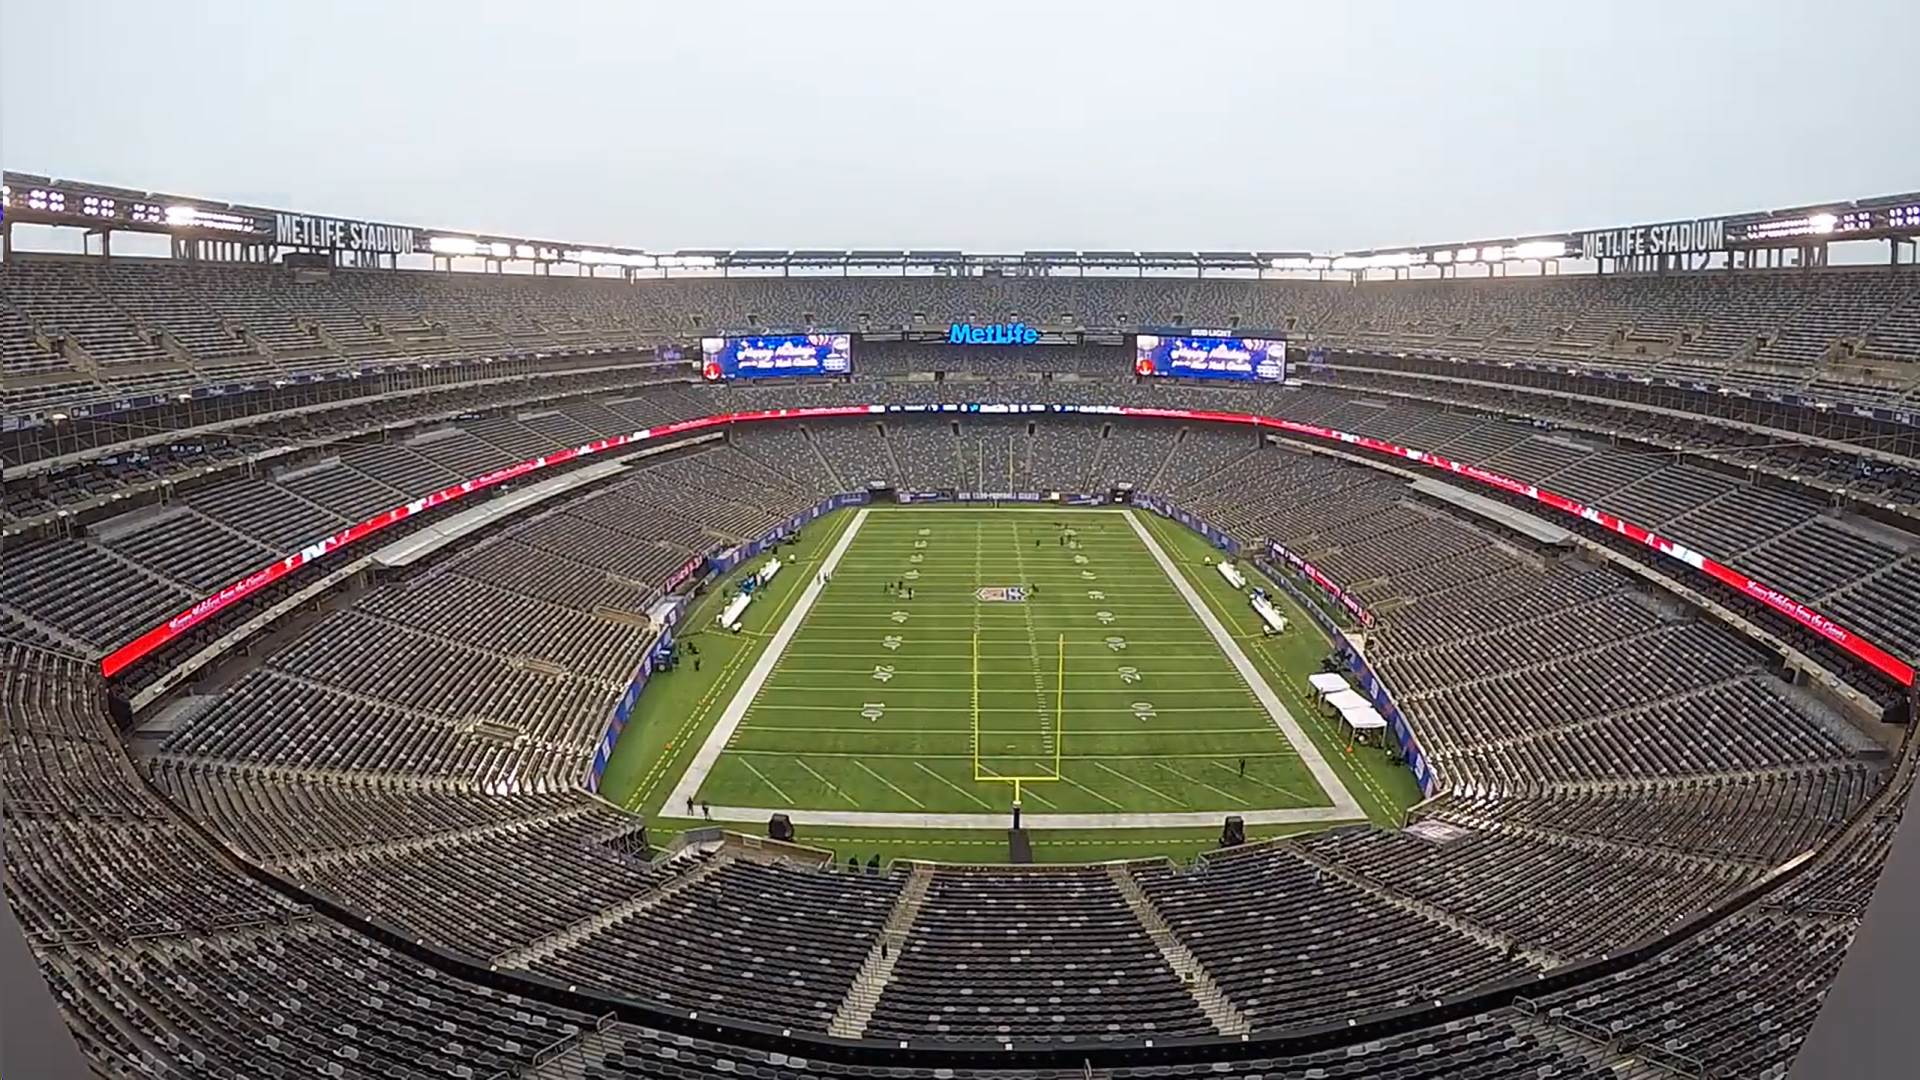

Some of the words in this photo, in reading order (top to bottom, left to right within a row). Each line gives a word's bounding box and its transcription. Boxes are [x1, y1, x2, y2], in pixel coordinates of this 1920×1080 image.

[276, 214, 346, 248] METLIFE
[350, 223, 414, 254] STADIUM
[1582, 228, 1646, 260] METLIFE
[1650, 220, 1724, 254] STADIUM
[950, 322, 1038, 344] MetLife
[873, 665, 896, 680] 20
[1117, 666, 1142, 682] 20
[860, 703, 886, 718] 10
[1131, 702, 1158, 717] 10
